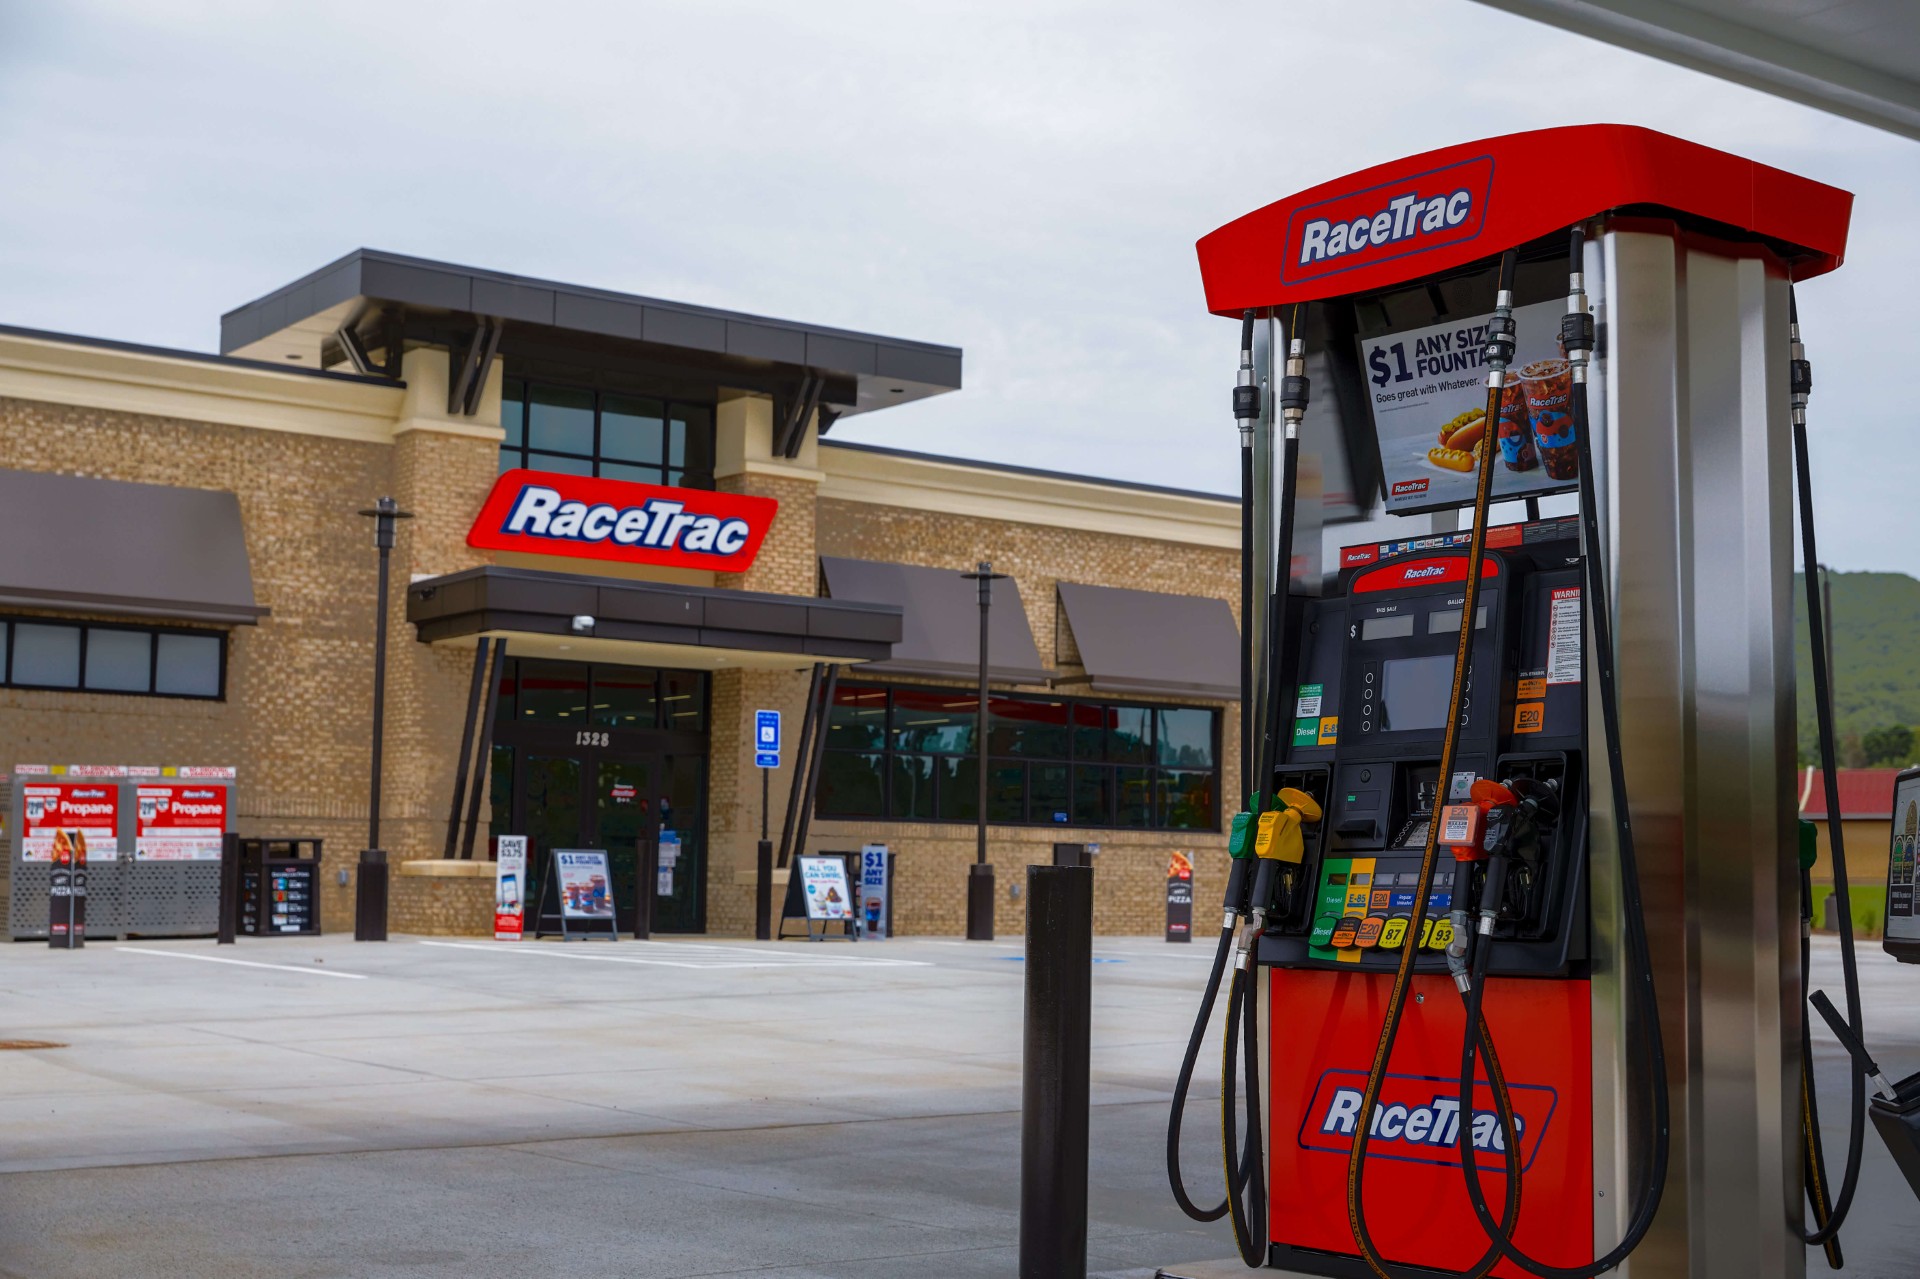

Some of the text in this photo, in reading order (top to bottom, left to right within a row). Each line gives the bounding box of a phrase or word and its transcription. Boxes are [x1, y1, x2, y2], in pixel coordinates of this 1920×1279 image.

[1299, 189, 1471, 266] RaceTrac
[1415, 333, 1452, 357] ANY
[1369, 341, 1413, 388] $1
[1416, 347, 1488, 378] FOUNTA
[1376, 378, 1480, 403] Goes great with Whatever.
[1530, 394, 1566, 406] RaceTrac
[1395, 482, 1426, 492] RaceTrac
[502, 485, 749, 555] RaceTrac
[1347, 553, 1371, 561] RaceTrac
[1404, 566, 1445, 579] RaceTrac
[1554, 589, 1580, 600] WARNI
[1350, 624, 1356, 638] $
[1520, 711, 1539, 722] E20
[576, 731, 609, 747] 1328
[60, 801, 114, 816] Propane
[171, 802, 223, 816] Propane
[1452, 807, 1468, 815] E20
[561, 854, 574, 865] $1
[865, 852, 884, 867] $1
[1349, 894, 1366, 903] E-85
[1374, 893, 1387, 902] E20
[1313, 927, 1333, 936] Diesel
[1359, 924, 1380, 935] E20
[1385, 929, 1401, 940] 87
[1435, 930, 1451, 941] 93
